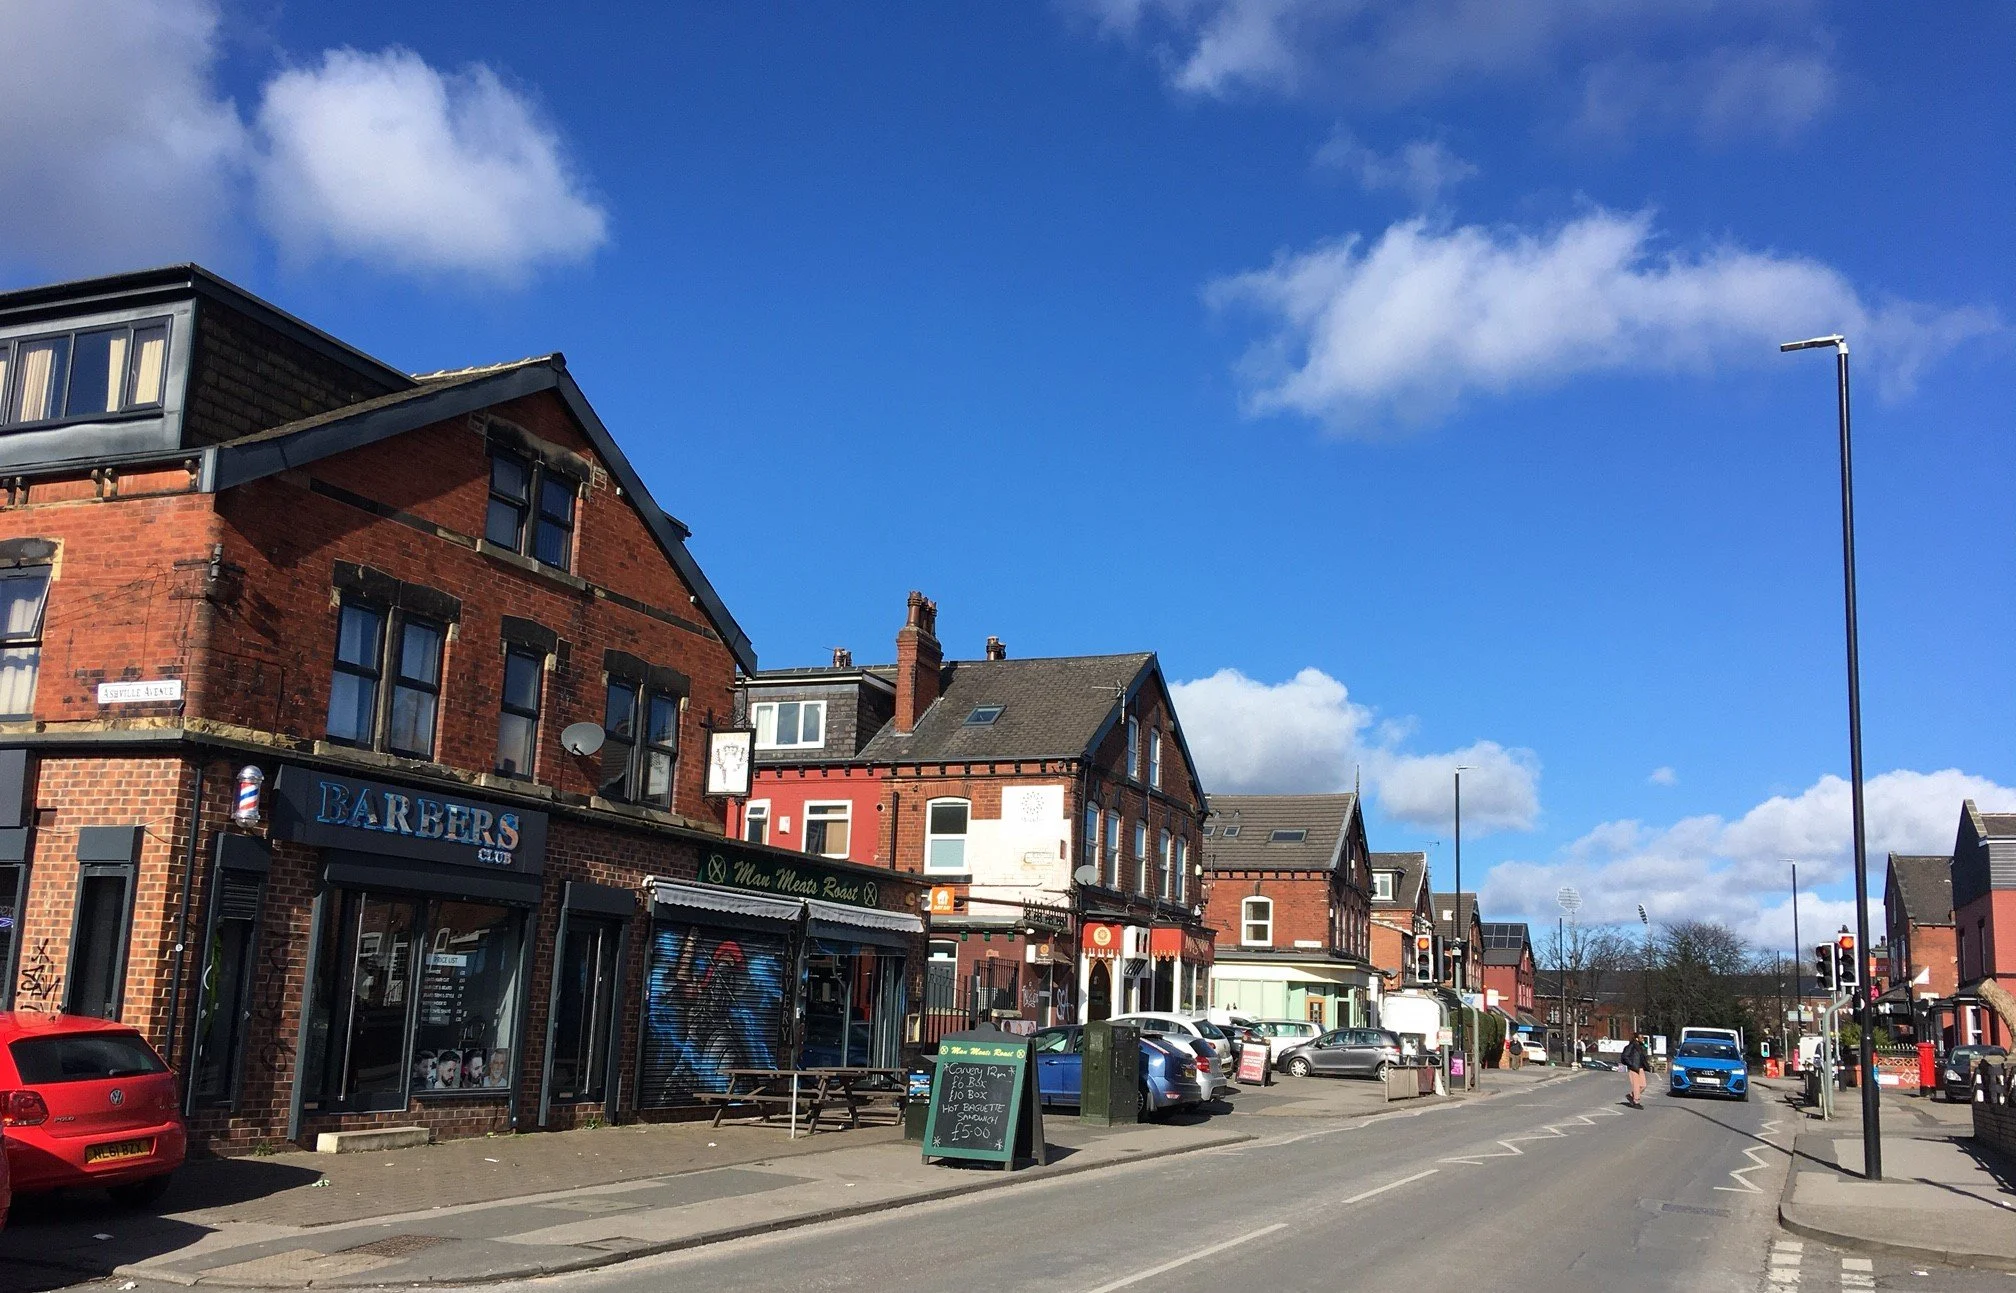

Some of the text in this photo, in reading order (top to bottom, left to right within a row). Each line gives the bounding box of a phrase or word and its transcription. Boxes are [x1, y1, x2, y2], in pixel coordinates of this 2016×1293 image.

[104, 686, 174, 699] ASHVILLE AVENUE
[316, 781, 520, 851] BARBERS
[477, 847, 512, 866] CLUB
[734, 860, 859, 901] Man Meats Roast
[782, 929, 796, 1042] CARVERY
[942, 1102, 1006, 1114] HOT BAGUETTE
[956, 1111, 999, 1125] SANDWICH
